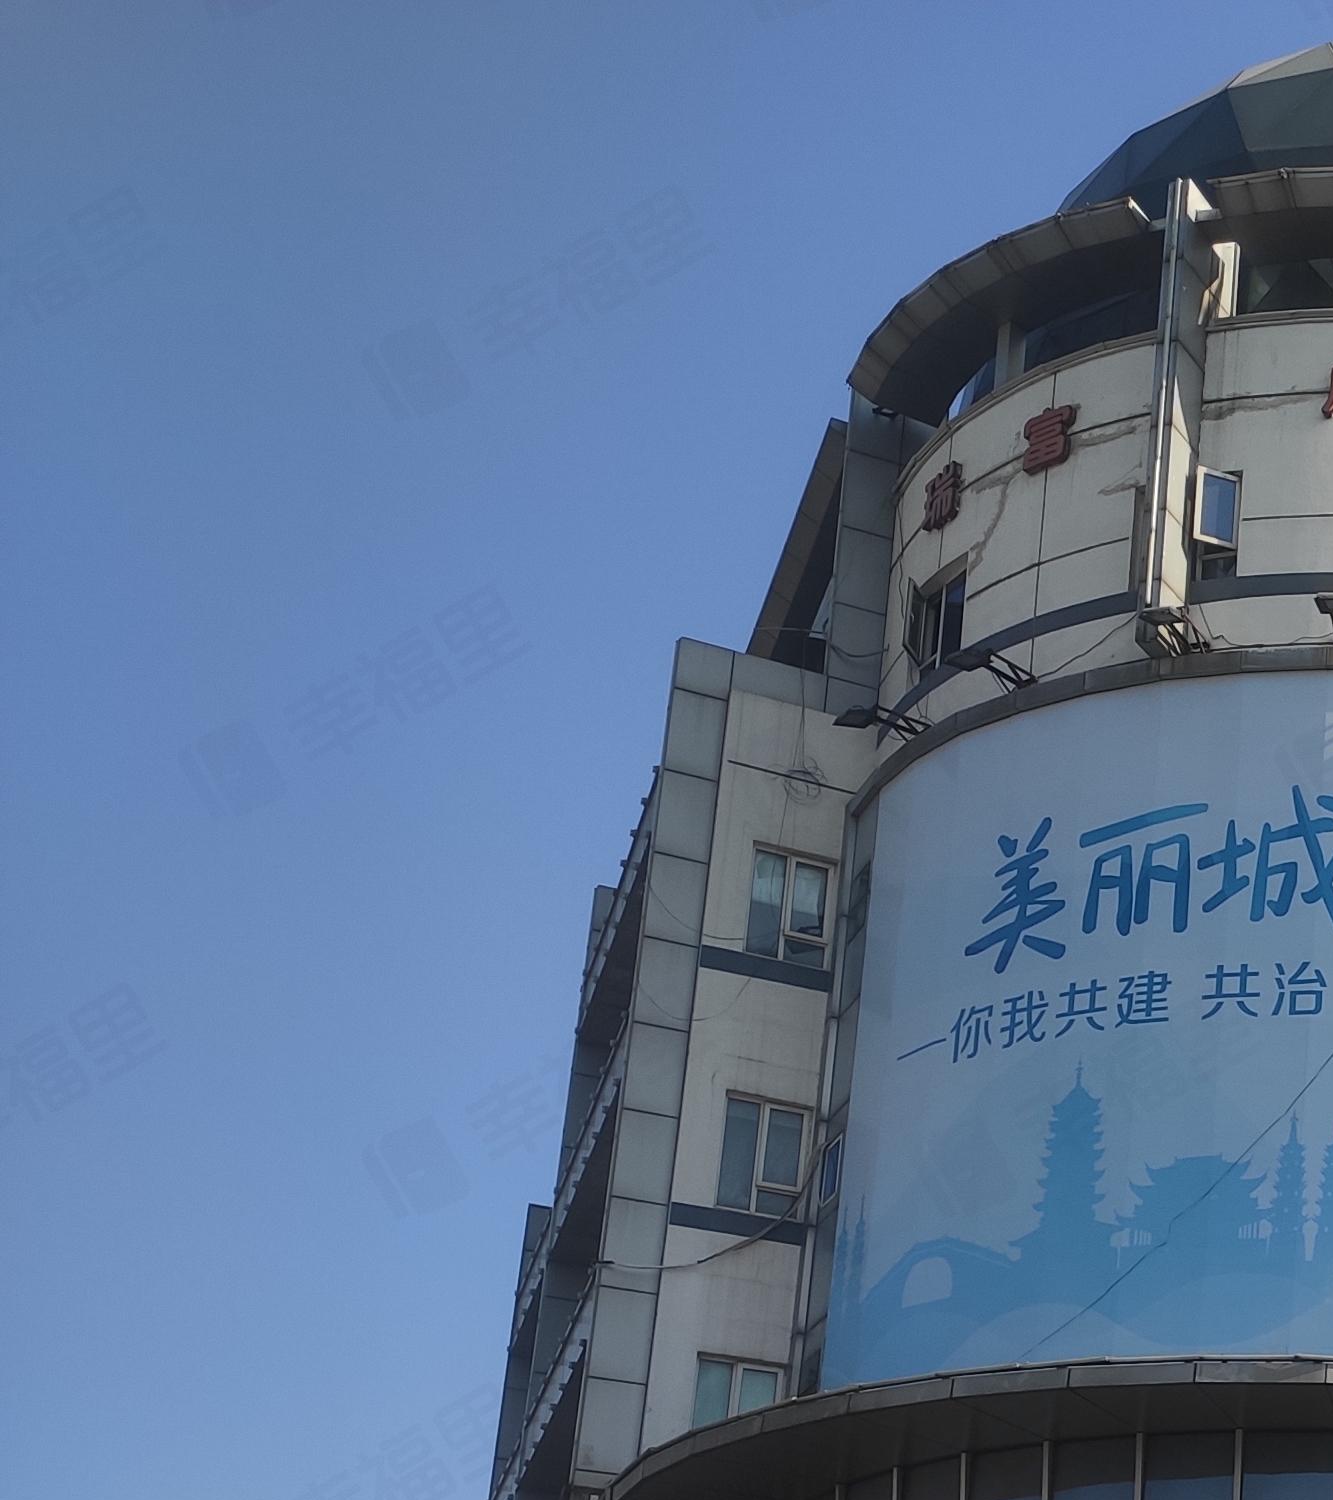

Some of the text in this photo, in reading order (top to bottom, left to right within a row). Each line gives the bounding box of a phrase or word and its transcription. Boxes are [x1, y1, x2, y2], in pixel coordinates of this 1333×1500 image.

[950, 970, 1172, 1064] 你我共建
[1201, 961, 1327, 1018] 共治
